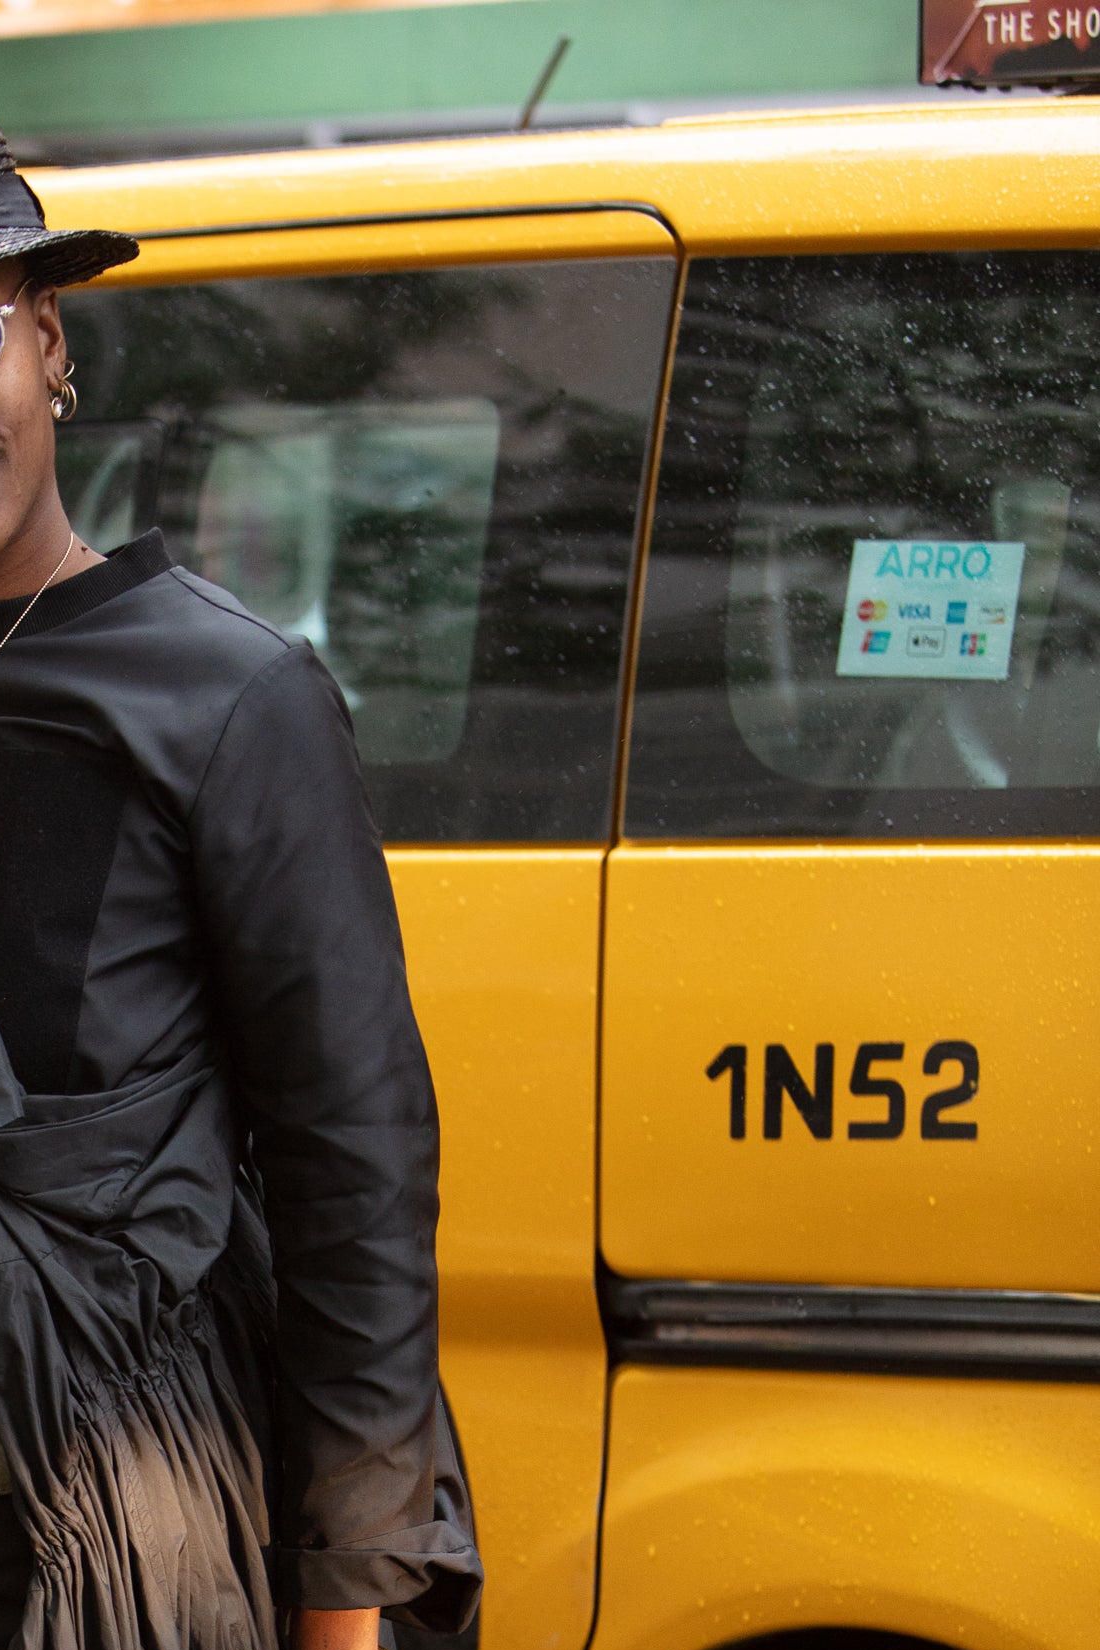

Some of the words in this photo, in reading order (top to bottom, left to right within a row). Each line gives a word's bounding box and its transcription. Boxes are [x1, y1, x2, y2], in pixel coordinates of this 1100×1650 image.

[983, 11, 1035, 45] THE
[1047, 7, 1100, 41] SHO
[875, 543, 991, 579] ARRO
[898, 603, 931, 620] VISA
[705, 1039, 980, 1141] 1N52
